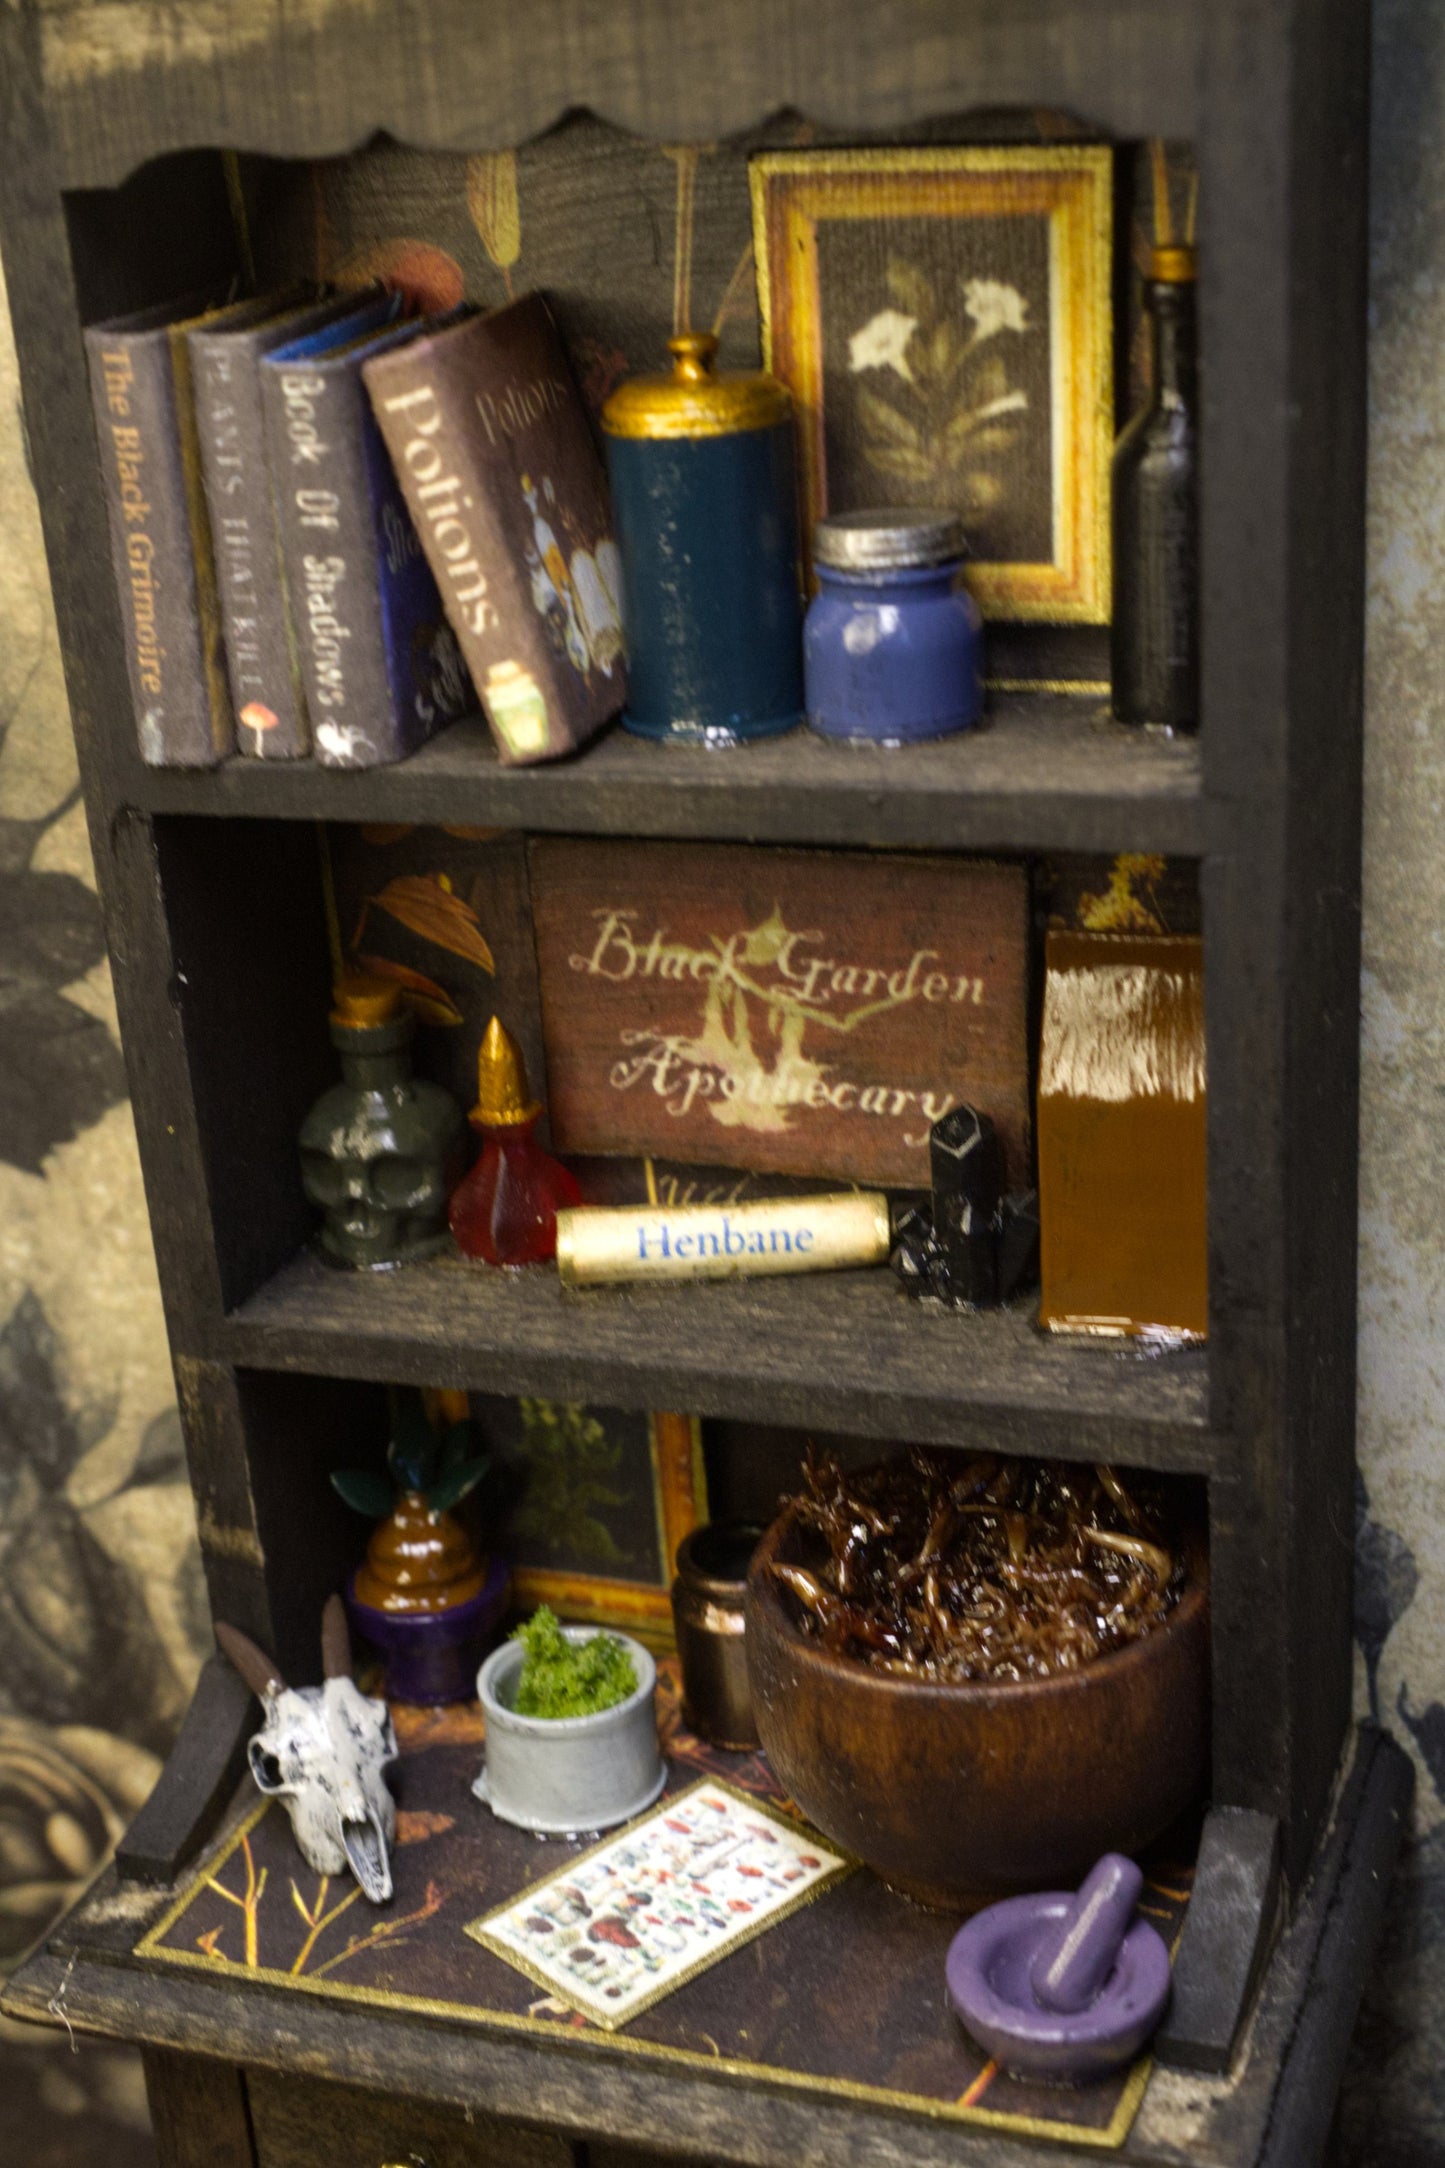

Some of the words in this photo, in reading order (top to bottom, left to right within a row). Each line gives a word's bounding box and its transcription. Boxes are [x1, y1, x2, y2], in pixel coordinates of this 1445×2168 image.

[101, 344, 134, 417] The
[281, 373, 331, 466] Book
[111, 423, 152, 524] Black
[295, 488, 341, 534] Of
[383, 385, 500, 636] Potions
[126, 532, 168, 694] Grimoire
[302, 554, 351, 707] Shadows
[567, 908, 752, 989] Black
[768, 928, 987, 1006] Garden
[636, 1214, 816, 1261] Henbane
